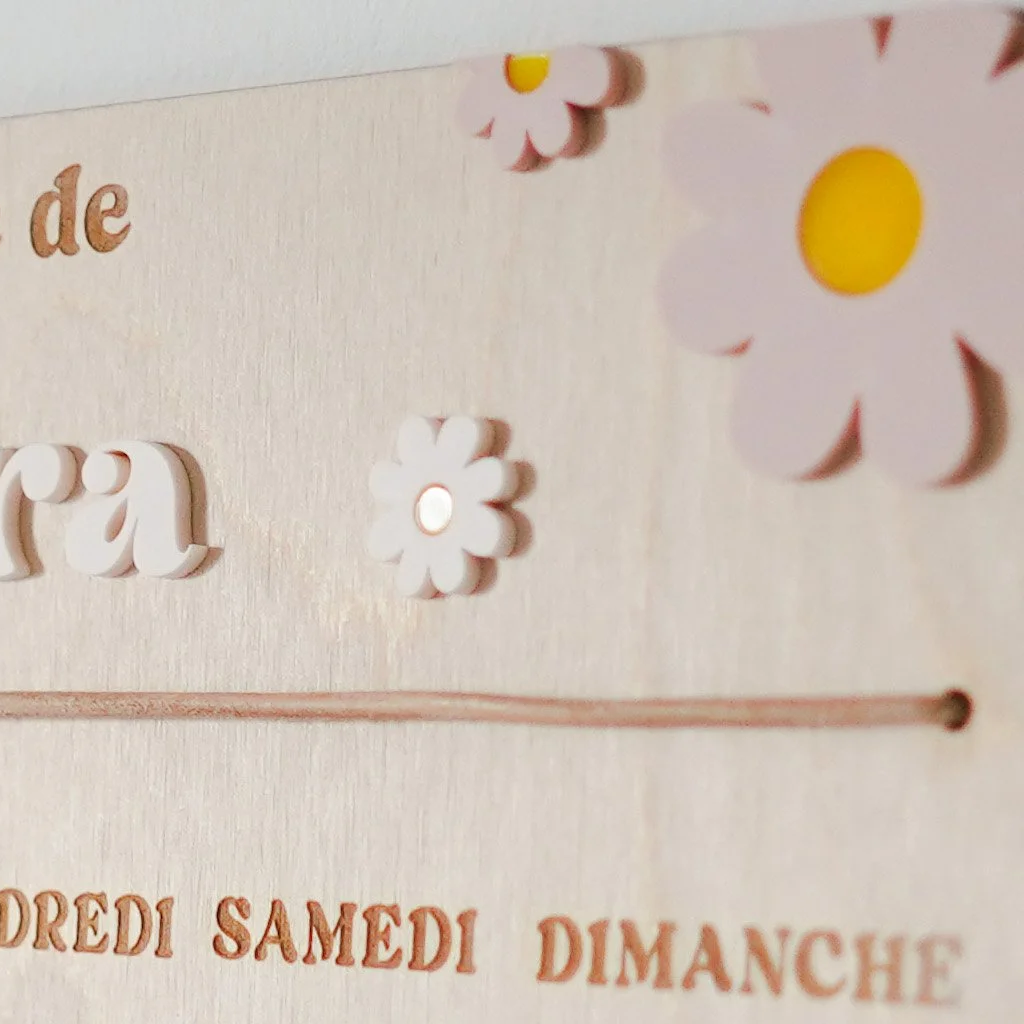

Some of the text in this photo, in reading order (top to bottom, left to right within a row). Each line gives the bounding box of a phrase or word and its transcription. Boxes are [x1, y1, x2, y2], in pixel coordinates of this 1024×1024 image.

[29, 163, 132, 259] de
[212, 896, 480, 974] SAMEDI
[536, 914, 965, 1007] DIMANCHE
